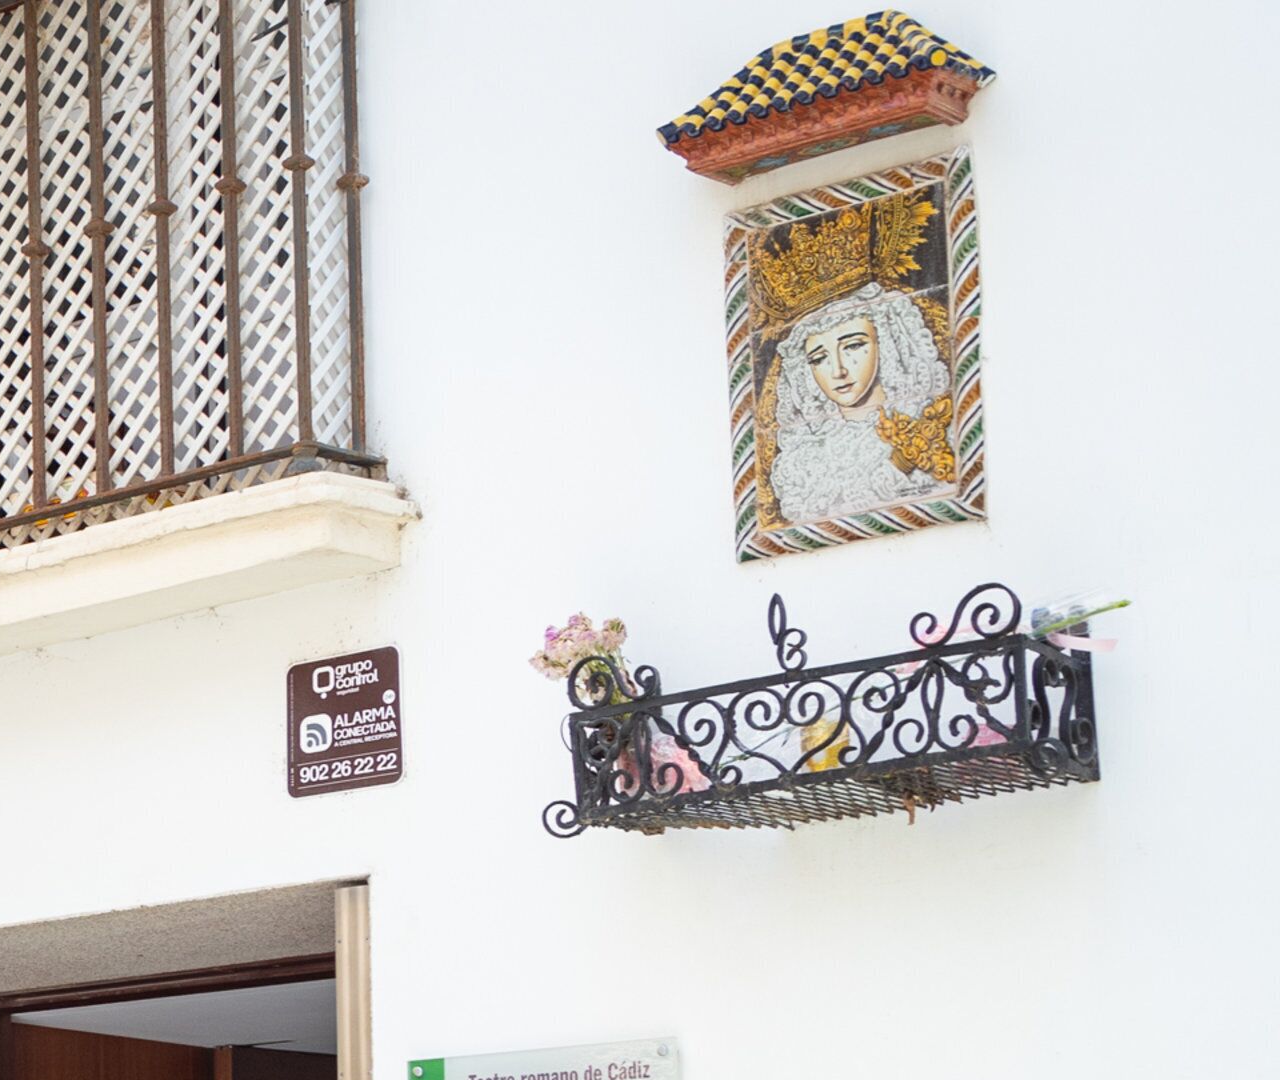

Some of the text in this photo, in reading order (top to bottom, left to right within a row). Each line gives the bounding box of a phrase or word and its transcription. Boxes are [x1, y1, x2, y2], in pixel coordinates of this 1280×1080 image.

[335, 660, 373, 679] grupo
[336, 668, 379, 689] control
[334, 705, 396, 729] ALARMA
[334, 721, 397, 740] CONECTADA
[300, 752, 397, 783] 902 26 22 22
[608, 1060, 651, 1080] Cádiz
